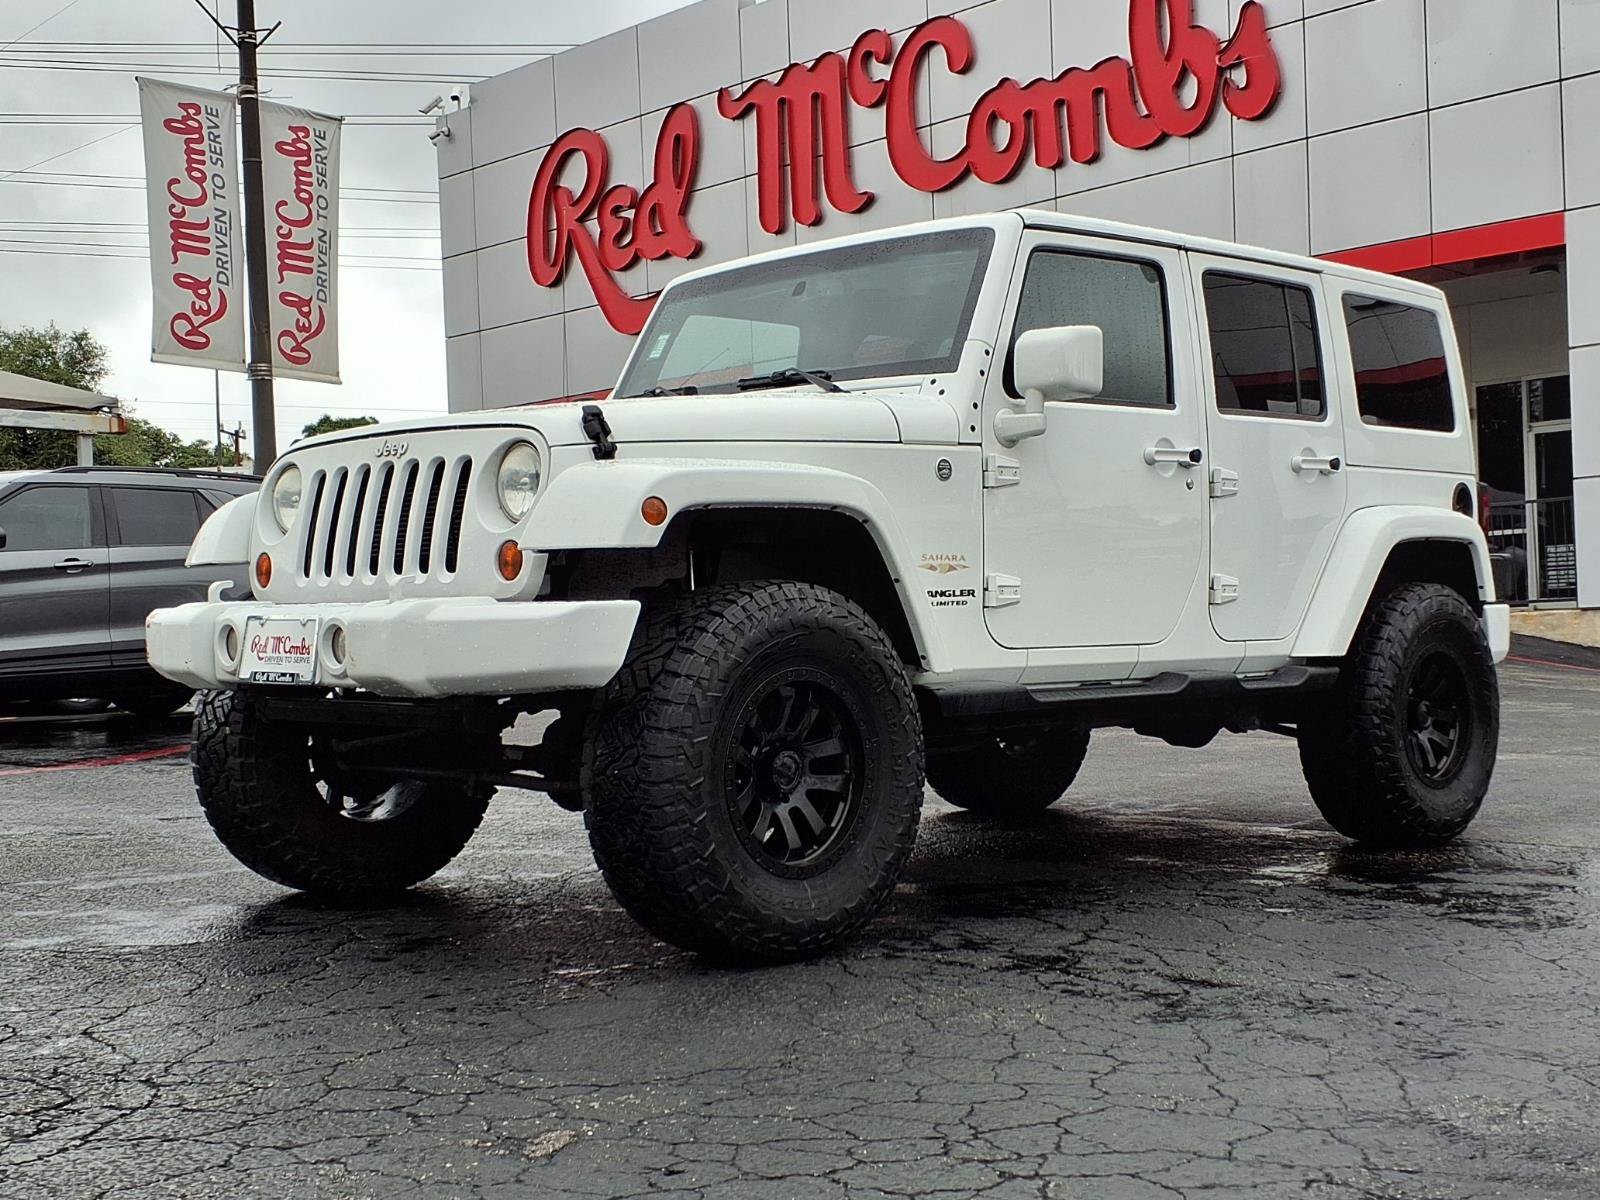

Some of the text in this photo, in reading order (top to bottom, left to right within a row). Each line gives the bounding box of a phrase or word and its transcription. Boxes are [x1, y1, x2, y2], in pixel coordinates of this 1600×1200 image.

[163, 102, 228, 351] Red McCombs
[205, 104, 227, 287] DRIVEN TO SERVE
[274, 125, 326, 366] Red McCombs
[313, 127, 329, 304] DRIVEN TO SERVE
[527, 0, 1282, 335] Red McCombs
[375, 439, 409, 459] Jeep
[921, 553, 967, 561] SAHARA
[251, 634, 311, 661] Red McCombs
[285, 656, 292, 664] TO
[293, 656, 311, 664] SERVE
